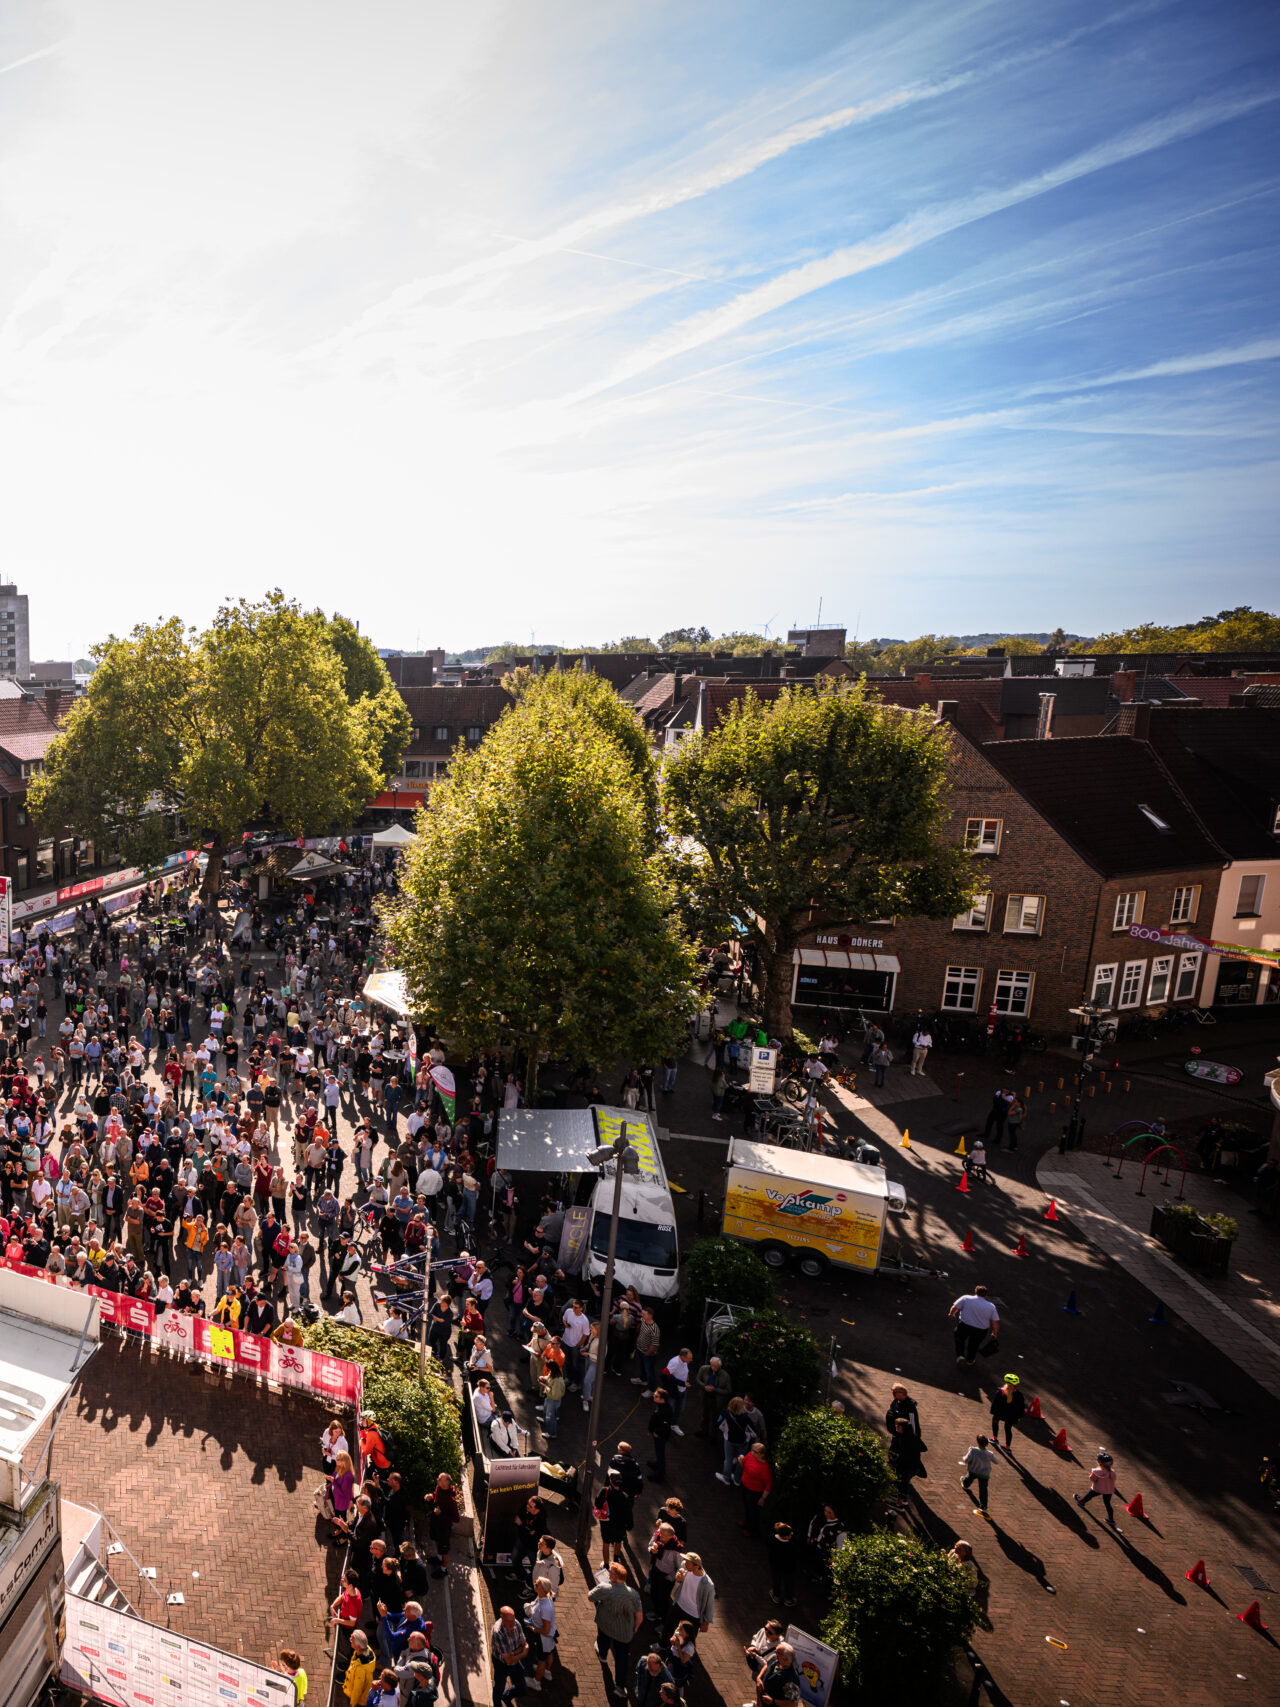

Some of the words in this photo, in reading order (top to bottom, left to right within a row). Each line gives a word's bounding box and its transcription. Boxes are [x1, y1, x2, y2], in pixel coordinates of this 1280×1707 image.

[816, 935, 838, 945] HAUS
[850, 937, 884, 949] DÖNERS
[1130, 925, 1161, 943] 800
[1165, 935, 1206, 952] Jahre
[765, 1188, 843, 1217] Voßkamp
[657, 1224, 673, 1232] ROSE
[513, 1481, 536, 1491] Blender
